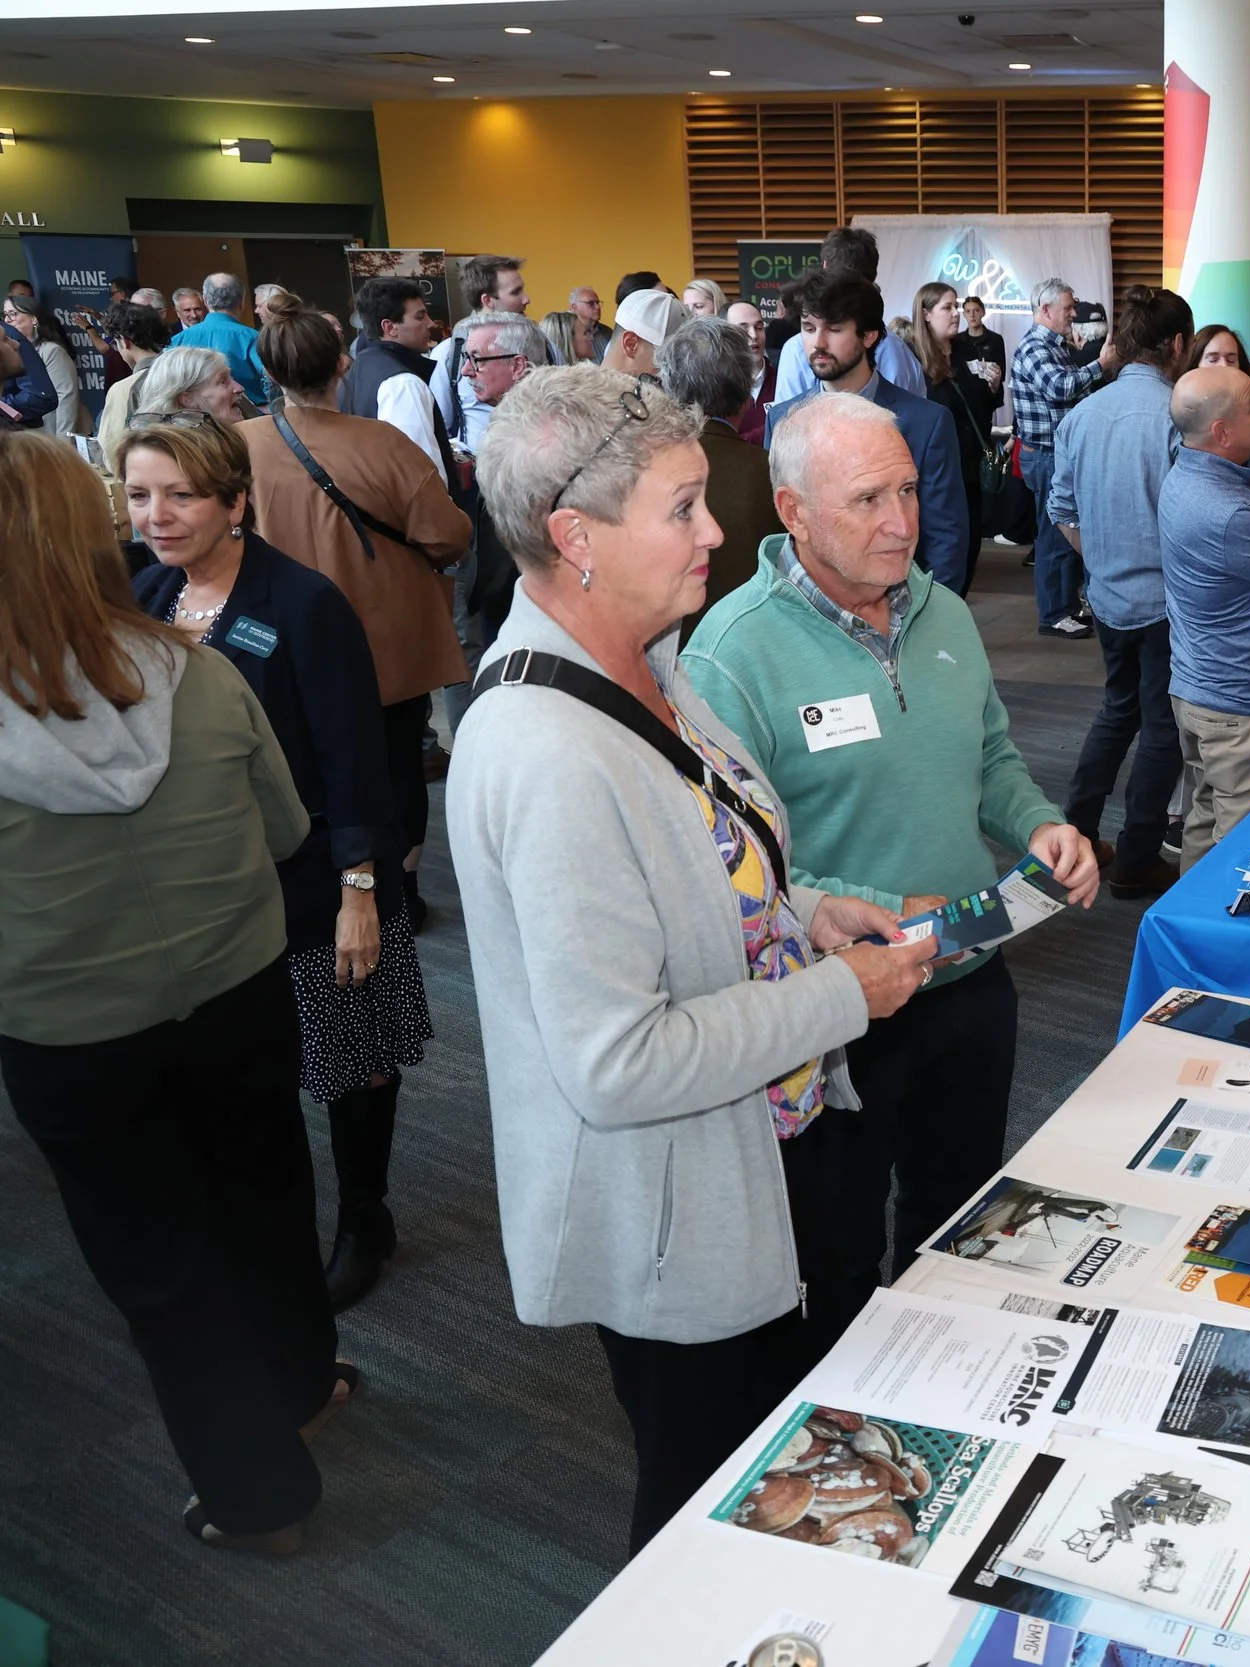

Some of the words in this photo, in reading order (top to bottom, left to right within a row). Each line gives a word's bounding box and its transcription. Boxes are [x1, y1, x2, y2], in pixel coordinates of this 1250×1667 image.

[761, 310, 779, 318] Bus
[1063, 1238, 1120, 1286] ROADMAP
[1091, 1243, 1138, 1286] Aquaculture
[1122, 1246, 1150, 1269] Maine
[995, 1365, 1057, 1429] MAIC
[956, 1435, 992, 1463] Sea
[995, 1441, 1022, 1472] Methods
[907, 1463, 976, 1535] Scallops
[950, 1483, 985, 1526] Production
[964, 1487, 995, 1524] Materials
